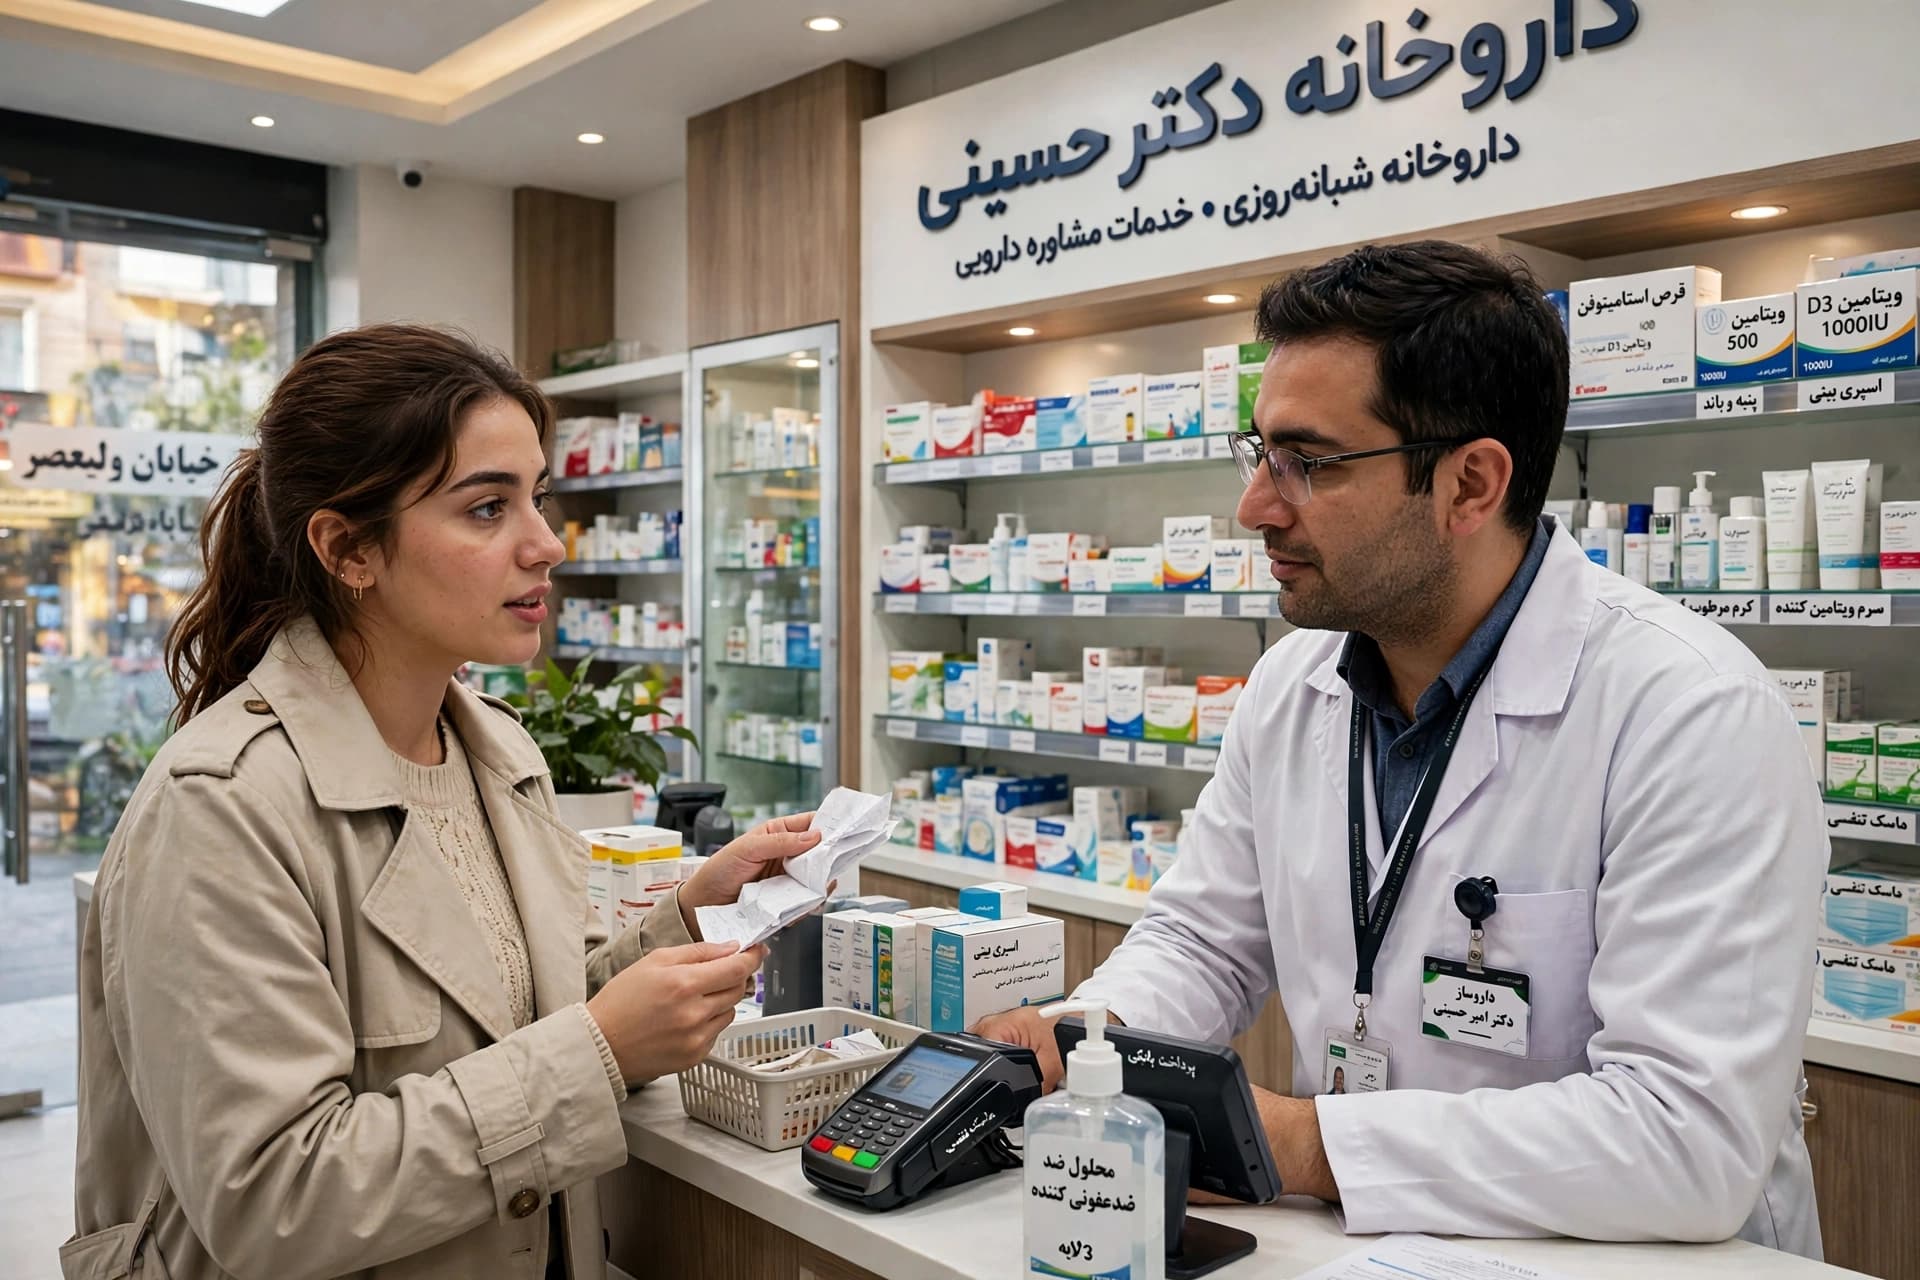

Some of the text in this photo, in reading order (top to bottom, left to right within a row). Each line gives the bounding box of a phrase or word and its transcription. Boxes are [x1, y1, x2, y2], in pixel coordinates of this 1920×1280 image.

[918, 0, 1639, 231] داروخانه دکتر حسینی
[1382, 126, 1519, 183] داروخانه
[1107, 198, 1193, 240] خدمات
[1027, 219, 1102, 265] مشاوره
[956, 235, 1021, 278] دارویی
[1652, 282, 1686, 307] قرص
[1807, 287, 1903, 314] ویتامین D3
[1731, 306, 1785, 330] ویتامین
[1822, 313, 1889, 337] 1000IU
[1727, 332, 1758, 351] 500
[1704, 394, 1757, 413] پنبه و باند
[1809, 378, 1882, 404] اسپری بینی
[22, 441, 218, 483] خیابان ولیعصر
[1732, 599, 1754, 618] کرم
[1775, 600, 1884, 619] سرم ویتامین کننده
[1827, 812, 1908, 830] ماسک تنفسی
[1830, 881, 1903, 898] ماسک تنفسی
[1823, 953, 1896, 973] ماسک تنفسی
[1455, 985, 1496, 1004] داروساز
[1433, 1003, 1514, 1028] دکتر امیر حسینی
[1043, 1154, 1115, 1180] محلول ضد
[1031, 1185, 1136, 1212] ضدعفونی کننده
